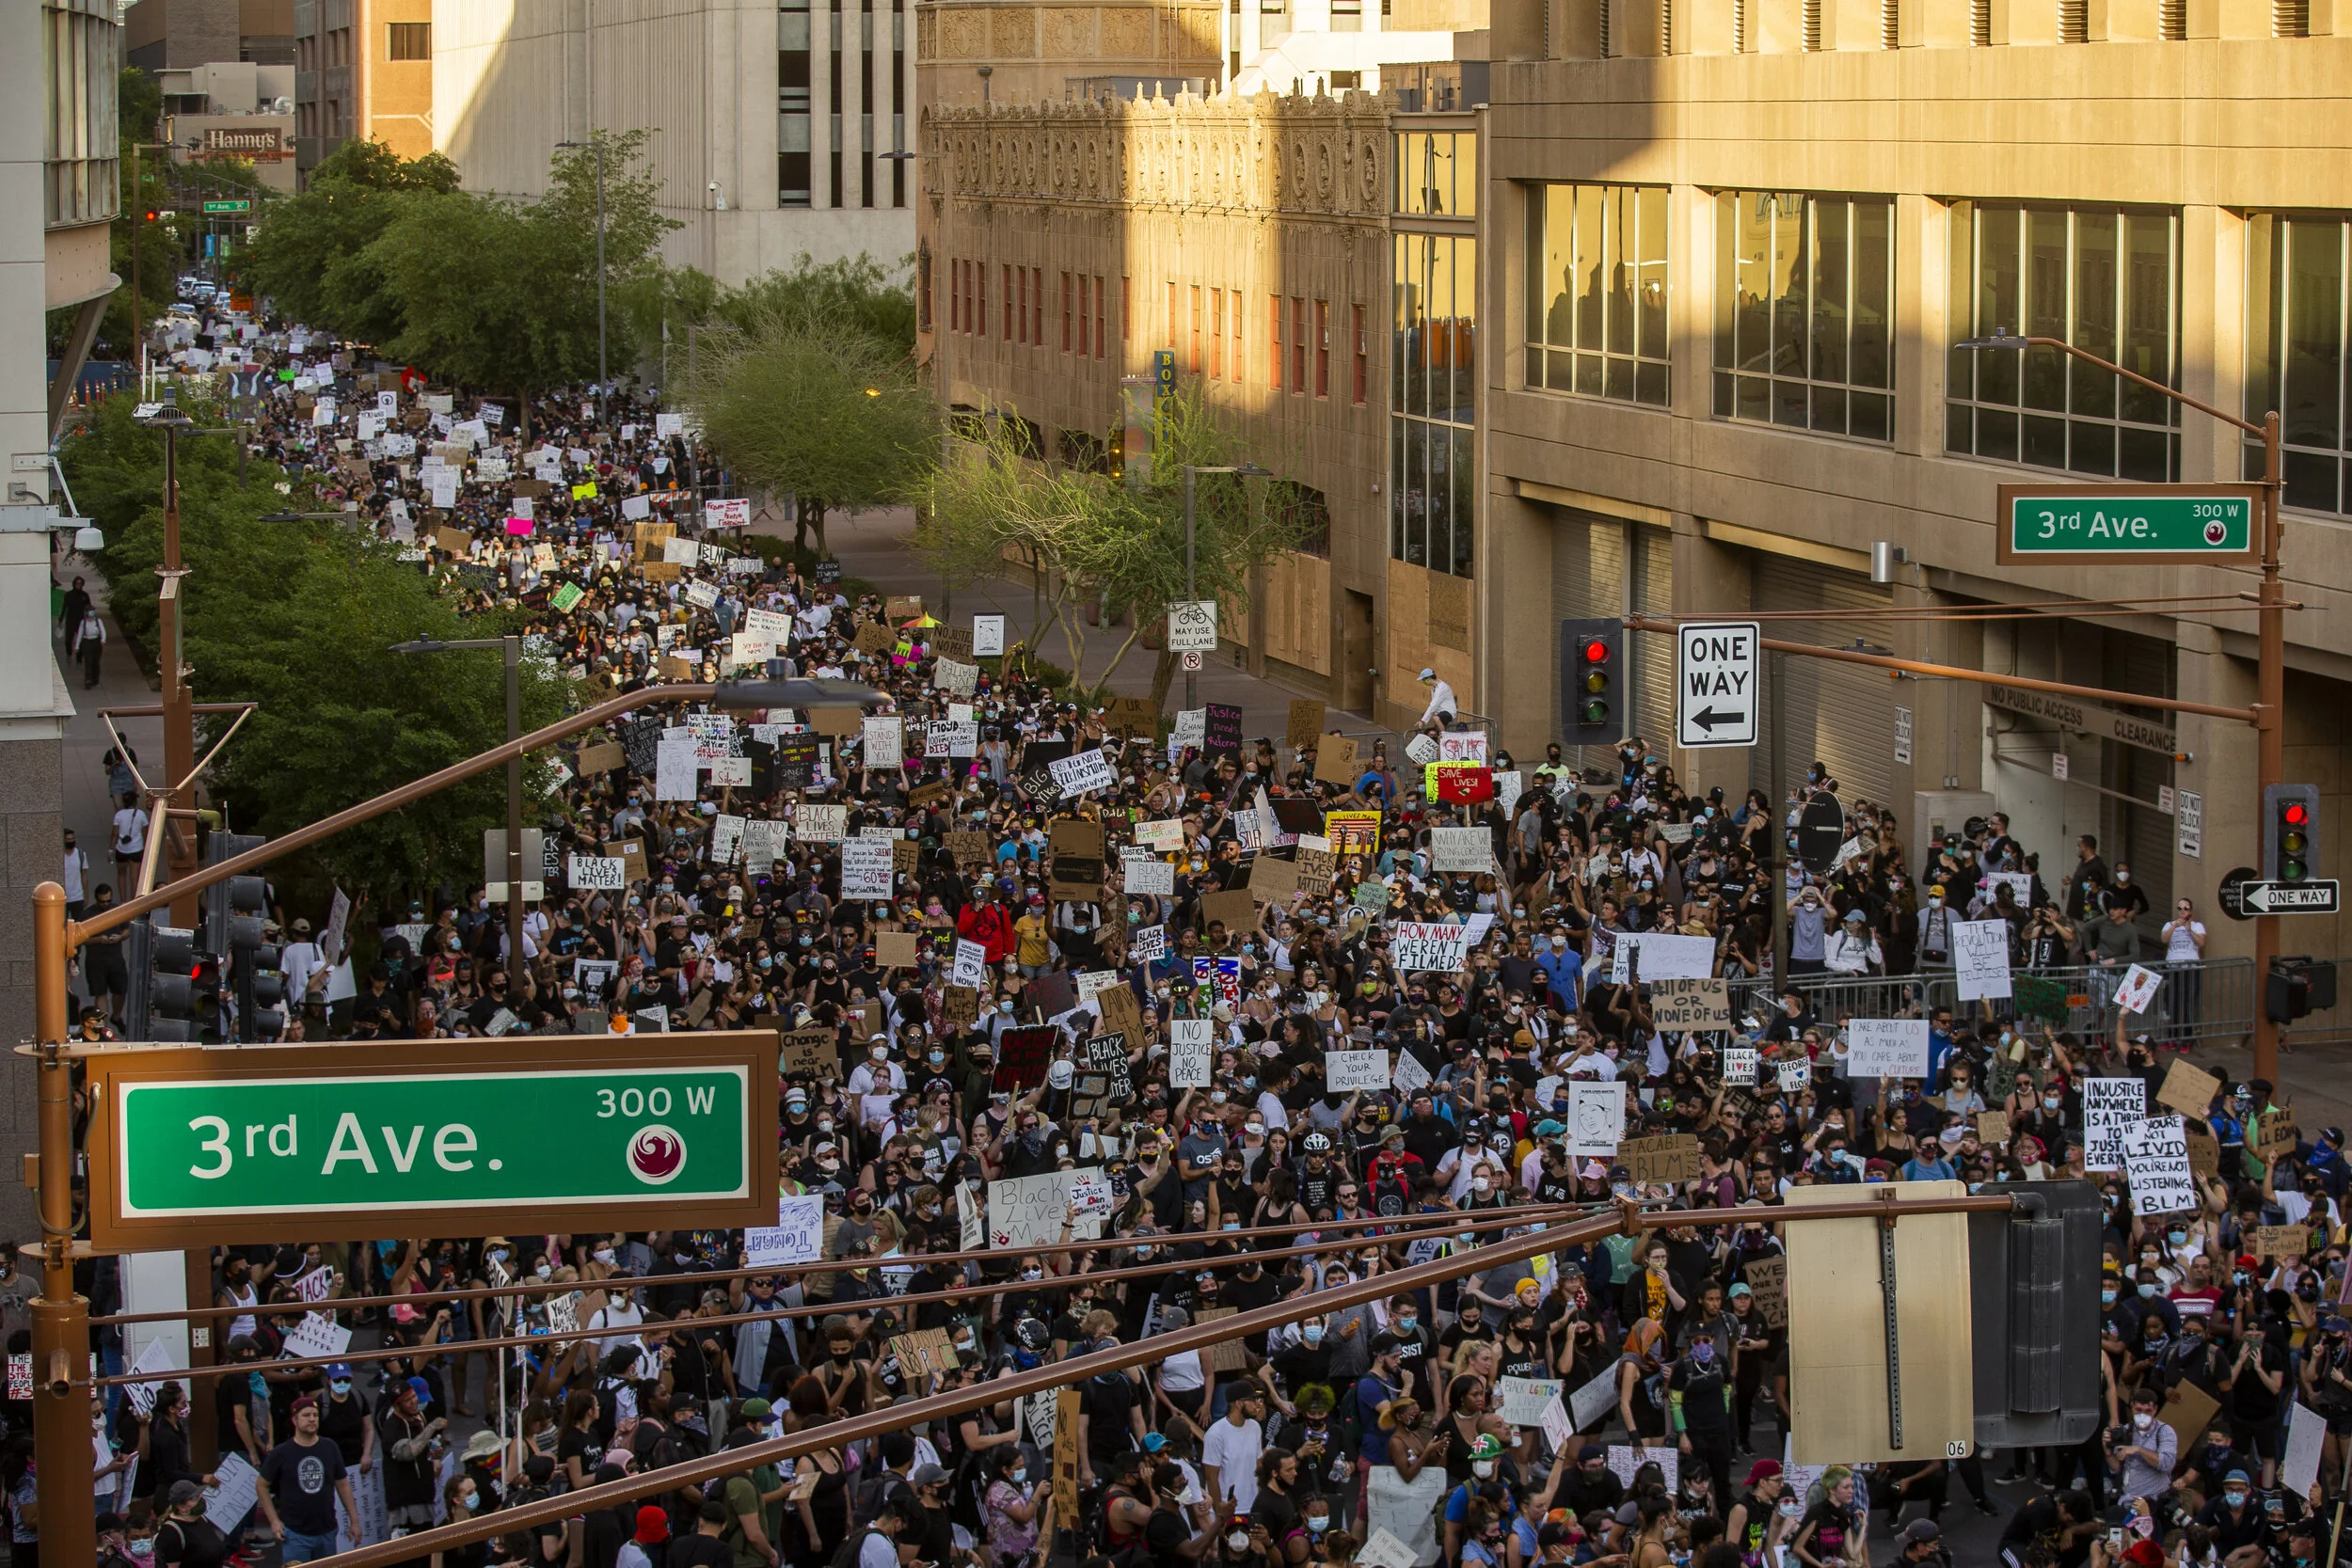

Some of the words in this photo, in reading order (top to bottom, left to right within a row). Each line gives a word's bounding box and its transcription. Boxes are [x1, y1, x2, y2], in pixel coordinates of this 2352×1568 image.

[211, 131, 275, 152] Hanny's
[2193, 505, 2222, 517] 300
[2226, 504, 2239, 517] W
[2038, 512, 2080, 538] 3rd
[2088, 512, 2157, 538] Ave.
[935, 625, 947, 638] NO
[936, 640, 948, 652] NO
[949, 642, 971, 657] PEACE
[1194, 638, 1214, 646] LANE
[1691, 637, 1748, 662] ONE
[1690, 671, 1749, 696] WAY
[1208, 705, 1241, 721] Justice
[1895, 708, 1902, 721] DO
[1991, 687, 2004, 703] NO
[2007, 691, 2042, 715] PUBLIC
[2043, 698, 2083, 726] ACCESS
[2115, 719, 2176, 753] CLEARANCE
[868, 731, 896, 740] STAND
[1213, 723, 1239, 735] needs
[1895, 724, 1911, 739] BLOCK
[870, 740, 892, 752] WITH
[930, 743, 949, 754] DIED
[1445, 739, 1466, 761] SAY
[1439, 768, 1462, 778] SAVE
[1025, 769, 1048, 795] BIG
[1454, 778, 1478, 787] LIVES!
[2180, 794, 2189, 808] DO
[2190, 797, 2201, 811] NOT
[799, 804, 838, 822] BLACK
[1343, 812, 1361, 820] LIVES
[806, 820, 834, 832] LIVES
[2180, 812, 2200, 829] BLOCK
[863, 828, 893, 836] RACISM
[1457, 830, 1477, 846] ARE
[1478, 832, 1491, 846] WE
[2180, 830, 2200, 844] ENTRANCE
[945, 833, 978, 846] BLACK
[874, 848, 892, 857] SILENT
[1120, 847, 1144, 856] JUSTICE
[1296, 847, 1338, 866] BLACK
[577, 857, 617, 869] BLACK
[1137, 863, 1171, 876] BLACK
[582, 867, 618, 877] LIVES
[863, 871, 877, 884] 60
[578, 873, 622, 887] MATTER!
[1136, 875, 1171, 885] LIVES
[1132, 882, 1172, 894] MATTER
[2268, 892, 2295, 904] ONE
[2299, 891, 2328, 903] WAY
[1139, 926, 1164, 942] BLACK
[1395, 921, 1423, 937] HOW
[1424, 923, 1459, 938] MANY
[1138, 938, 1163, 952] LIVES
[1393, 936, 1454, 951] WEREN'T
[1644, 937, 1671, 953] NO
[1954, 932, 2006, 947] REVOLUTION
[958, 948, 983, 958] OVERSIGHT
[961, 943, 981, 953] CIVILIAN
[1137, 946, 1165, 962] MATTER
[1966, 943, 2001, 958] WILL
[964, 954, 981, 963] POLICE
[1394, 949, 1457, 966] FILMED?
[1972, 956, 1992, 970] BE
[1957, 965, 2009, 981] TELEVISED
[955, 976, 977, 988] NOW!
[1678, 979, 1696, 993] OF
[1701, 980, 1723, 994] US
[1674, 996, 1704, 1007] OR
[1654, 1008, 1691, 1024] NONE
[1693, 1007, 1710, 1022] OF
[1713, 1008, 1730, 1021] US
[1183, 1022, 1201, 1040] NO
[1853, 1022, 1872, 1034] CARE
[1875, 1022, 1899, 1034] ABOUT
[1905, 1022, 1920, 1036] US
[783, 1034, 829, 1048] Change
[1002, 1027, 1057, 1054] RACISM
[1864, 1037, 1874, 1047] AS
[1879, 1037, 1897, 1048] MUCH
[1899, 1039, 1911, 1049] AS
[803, 1048, 814, 1057] is
[1089, 1036, 1124, 1061] BLACK
[1171, 1042, 1212, 1056] JUSTICE
[1725, 1049, 1755, 1061] BLACK
[792, 1056, 821, 1067] near
[1182, 1056, 1197, 1069] NO
[1341, 1052, 1375, 1063] CHECK
[1852, 1050, 1867, 1062] YOU
[1871, 1051, 1892, 1062] CARE
[1897, 1052, 1920, 1063] ABOUT
[1345, 1063, 1372, 1073] YOUR
[1780, 1058, 1809, 1072] GEORGE
[1866, 1065, 1882, 1075] OUR
[1888, 1064, 1921, 1075] CULTURE
[993, 1063, 1047, 1090] VIRUS
[1175, 1068, 1202, 1083] PEACE
[1335, 1074, 1385, 1086] PRIVILEGE
[1725, 1074, 1756, 1085] MATTER
[1073, 1076, 1106, 1095] LESS
[2087, 1081, 2144, 1098] INJUSTICE
[596, 1086, 672, 1117] 300
[686, 1086, 715, 1115] W
[2086, 1098, 2143, 1112] ANYWHERE
[2086, 1113, 2100, 1128] IS
[2103, 1113, 2111, 1126] A
[2113, 1112, 2145, 1126] THREAT
[2272, 1110, 2291, 1124] ARE
[2106, 1128, 2122, 1140] TO
[2123, 1123, 2136, 1134] IF
[2144, 1130, 2166, 1140] NOT
[188, 1114, 299, 1180] 3rd
[321, 1112, 503, 1176] Ave.
[1637, 1137, 1680, 1153] ACAB!
[2125, 1141, 2187, 1159] LIVID
[1637, 1153, 1685, 1180] BLM
[2168, 1162, 2189, 1172] NOT
[2130, 1177, 2192, 1191] LISTENING
[1072, 1186, 1104, 1200] Justice
[1076, 1202, 1113, 1216] JOHNSON
[2259, 1227, 2279, 1237] END
[752, 1230, 813, 1254] TONGA
[1415, 1240, 1434, 1251] NO
[2264, 1237, 2305, 1252] Brutality!
[1751, 1263, 1785, 1279] WE
[1752, 1278, 1772, 1291] OUR
[1756, 1292, 1781, 1304] NOW
[1762, 1303, 1779, 1312] IS
[299, 1324, 335, 1344] LIVES
[292, 1333, 333, 1354] MATTER
[11, 1354, 32, 1365] THE
[1503, 1380, 1527, 1394] BLACK
[1529, 1383, 1559, 1397] LGBTQ+
[1948, 1442, 1964, 1456] 06
